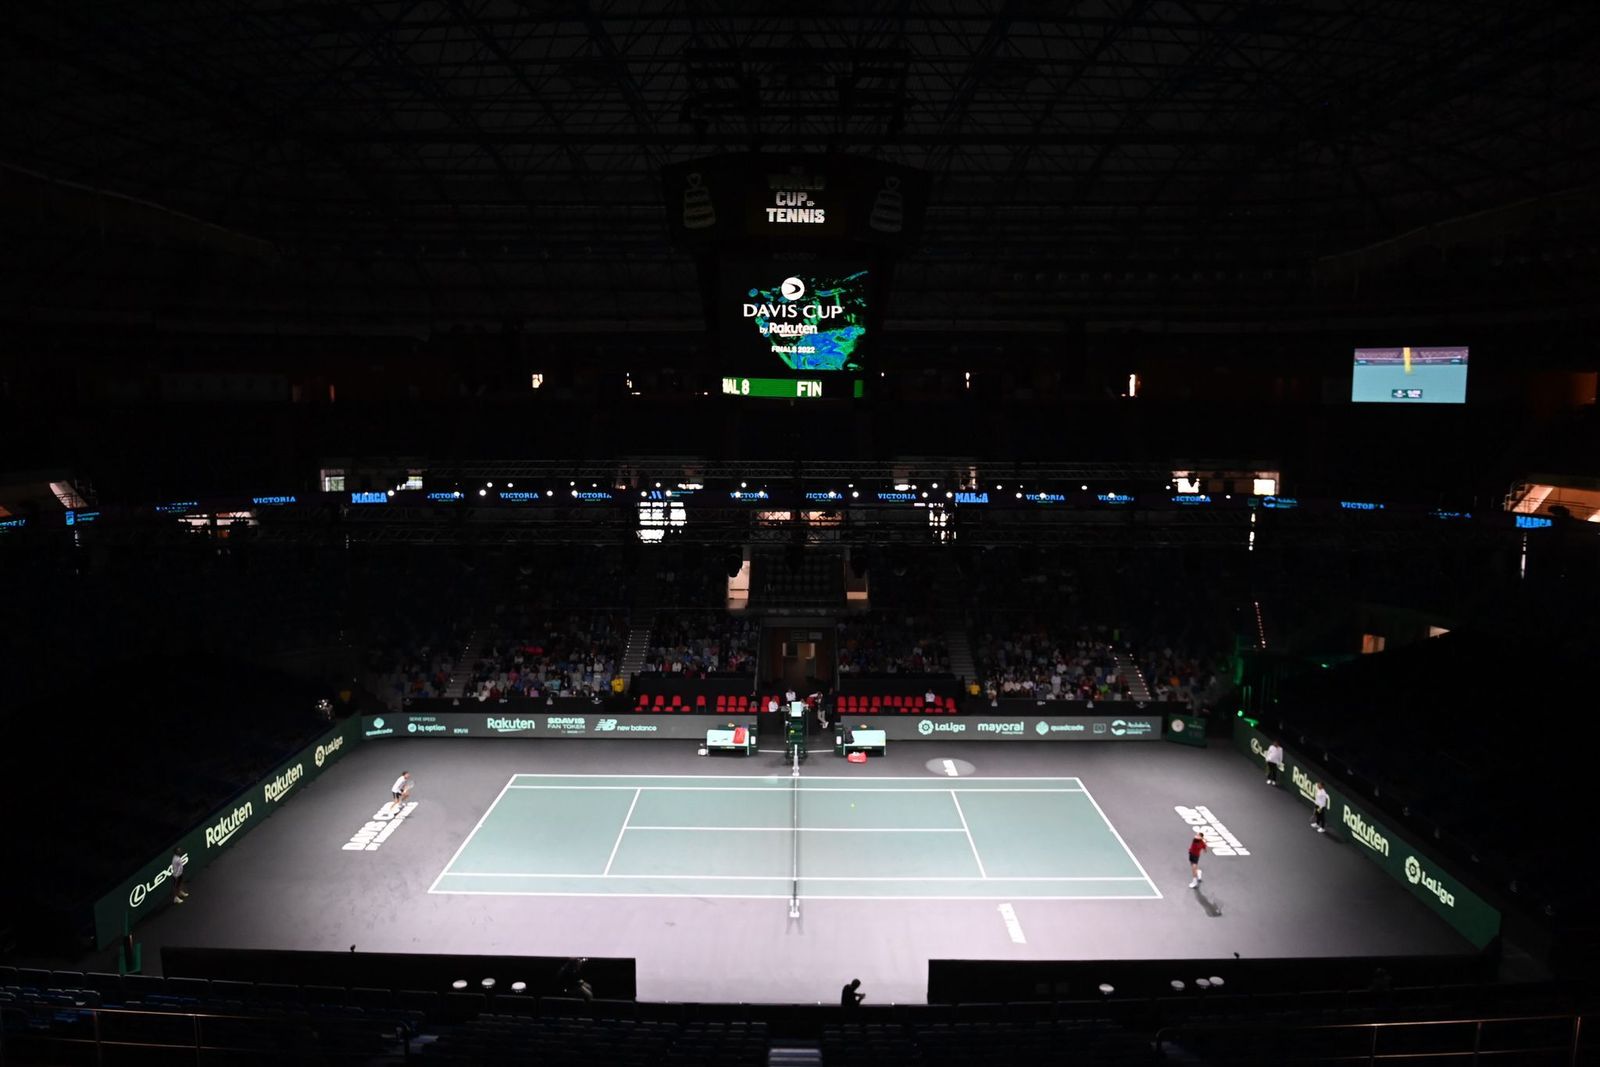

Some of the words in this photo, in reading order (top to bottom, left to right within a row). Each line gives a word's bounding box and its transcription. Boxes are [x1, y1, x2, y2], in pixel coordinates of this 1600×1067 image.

[775, 191, 808, 207] CUP
[765, 207, 826, 224] TENNIS
[743, 303, 798, 318] DAVIS
[802, 304, 844, 319] CUP
[759, 325, 769, 335] by
[769, 322, 818, 336] Rakuten
[771, 345, 797, 353] FINALS
[797, 346, 816, 354] 2022
[741, 378, 750, 395] 8
[796, 380, 822, 397] FIN
[252, 495, 296, 505] VICTORIA
[351, 491, 388, 504] MARCA
[425, 724, 446, 732] option
[486, 717, 536, 731] Rakuten
[631, 724, 657, 732] balance
[934, 722, 966, 733] LaLiga
[977, 721, 1025, 733] mayoral
[325, 736, 344, 756] LaLiga
[264, 763, 304, 803] Rakuten
[205, 801, 253, 848] Rakuten
[1342, 804, 1389, 857] Rakuten
[146, 853, 189, 892] LEXS
[1421, 871, 1455, 907] LaLiga
